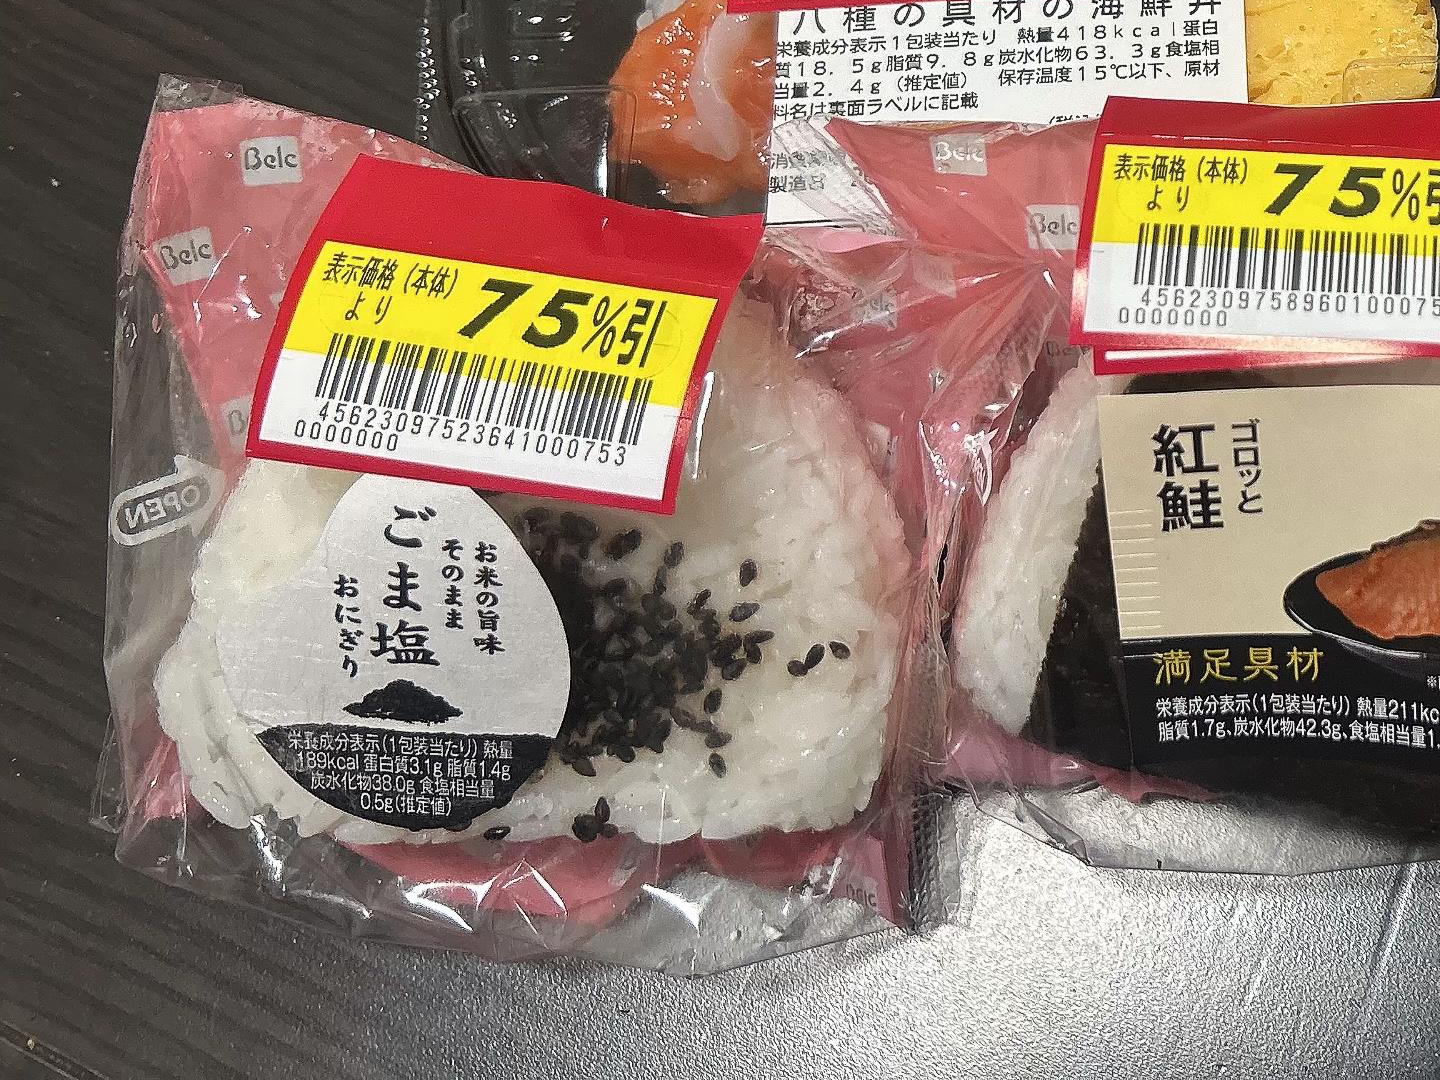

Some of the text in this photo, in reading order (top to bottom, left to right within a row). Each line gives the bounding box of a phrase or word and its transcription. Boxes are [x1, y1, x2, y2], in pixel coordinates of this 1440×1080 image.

[777, 29, 997, 59] 栄養成分表示1包装当たり
[774, 91, 979, 120] 料名は裏面ラベルに記載
[244, 145, 299, 171] Belc
[1146, 186, 1190, 212] より
[1029, 212, 1078, 235] Belc
[159, 239, 212, 270] Belc
[343, 294, 392, 326] より
[458, 276, 668, 370] 75%引
[1118, 306, 1229, 328] 0000000
[294, 419, 399, 453] 0000000
[317, 401, 627, 467] 45623097523641000753
[1150, 423, 1225, 532] 紅鮭
[1231, 417, 1264, 516] ゴロッと
[370, 505, 441, 667] ごま塩
[442, 538, 465, 630] そのまま
[473, 541, 506, 655] お米の旨味
[333, 574, 364, 678] おにぎり
[1152, 645, 1325, 687] 満足具材
[1156, 694, 1350, 719] 栄養成分表示(1包装当たり)
[482, 739, 514, 760] 熱量
[298, 750, 512, 781] 189kcal 蛋白質3.1g 脂質1.4g
[310, 771, 496, 799] 炭水化物38.0g 食塩相当量
